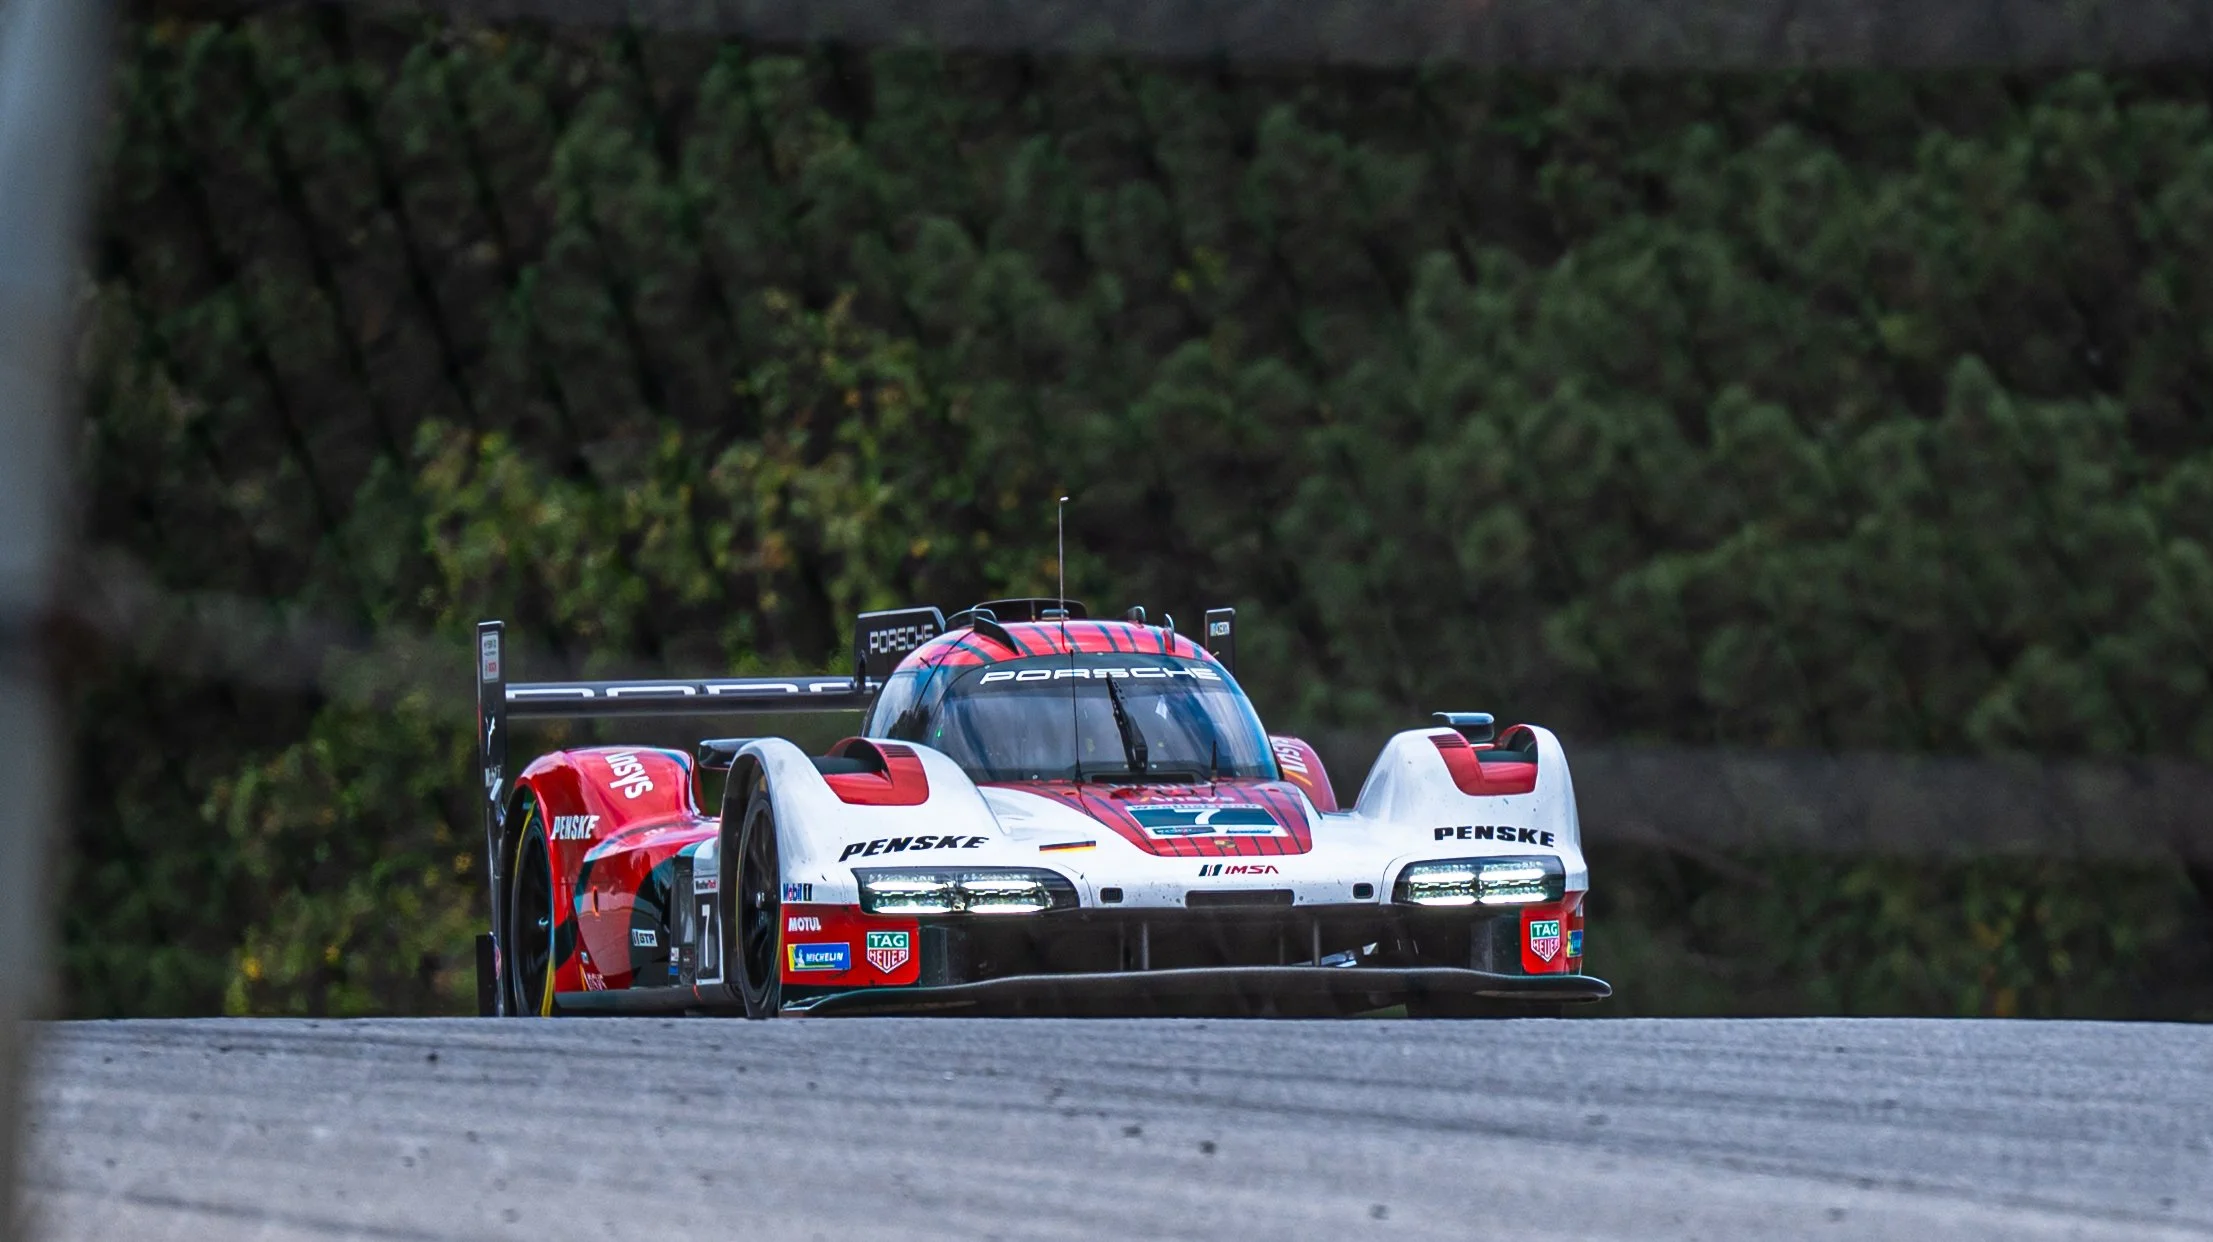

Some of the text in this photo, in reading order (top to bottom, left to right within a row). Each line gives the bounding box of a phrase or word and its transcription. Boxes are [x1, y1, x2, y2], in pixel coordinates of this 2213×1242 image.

[870, 623, 934, 655] PORSCHE
[980, 667, 1222, 685] PORSCHE
[550, 815, 600, 840] PENSKE
[1434, 825, 1555, 848] PENSKE
[838, 835, 990, 862] PENSKE
[1224, 865, 1279, 875] IMSA
[788, 916, 822, 932] MOTUL
[1533, 923, 1558, 937] TAG
[639, 933, 655, 944] GTP
[701, 904, 711, 968] 7
[870, 935, 905, 947] TAG
[805, 951, 844, 963] MICHELIN
[1533, 939, 1558, 957] HEUER
[869, 949, 906, 969] HEUER
